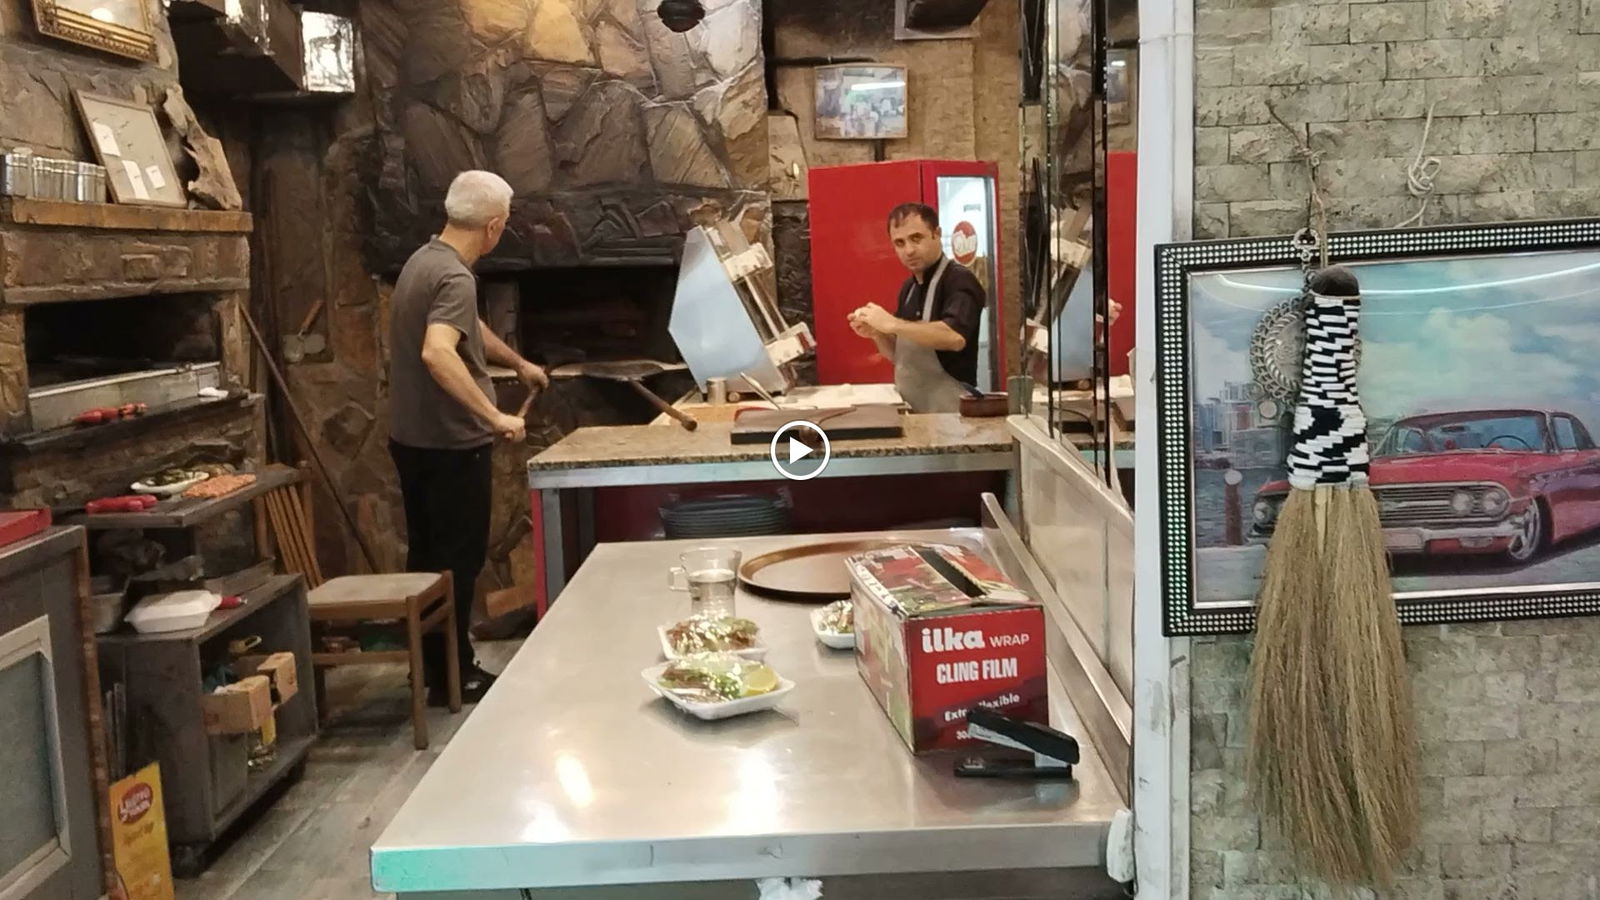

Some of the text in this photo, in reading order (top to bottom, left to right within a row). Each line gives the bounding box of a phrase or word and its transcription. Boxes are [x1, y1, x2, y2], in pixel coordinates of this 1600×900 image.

[921, 627, 1030, 653] ilka WRAP
[936, 657, 1018, 684] CLING FILM
[944, 708, 968, 722] Extr
